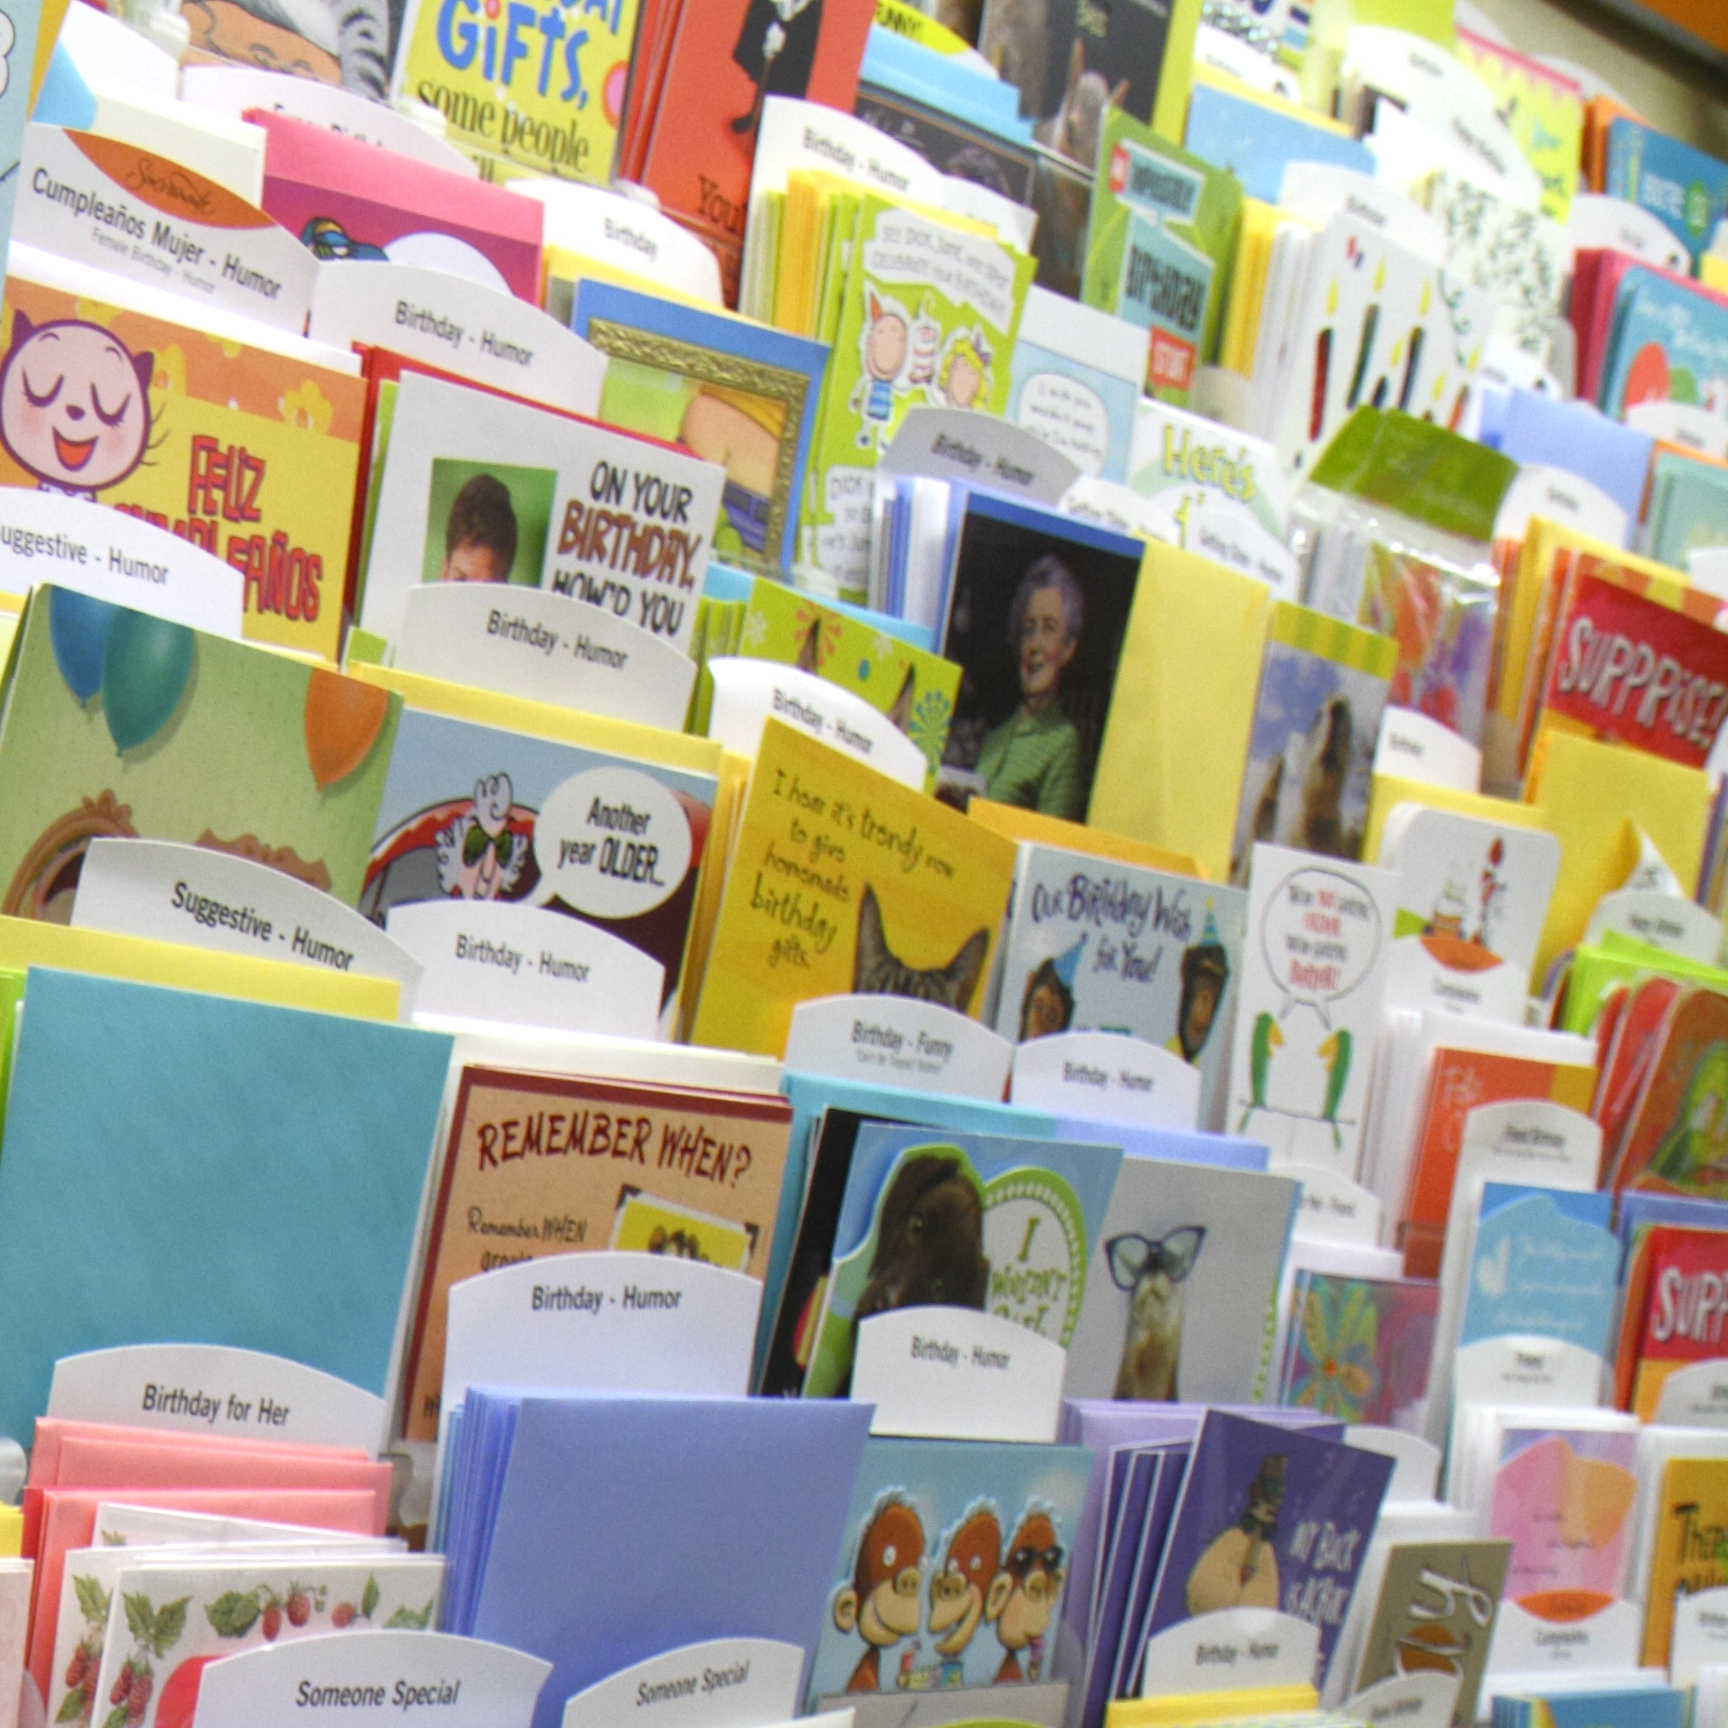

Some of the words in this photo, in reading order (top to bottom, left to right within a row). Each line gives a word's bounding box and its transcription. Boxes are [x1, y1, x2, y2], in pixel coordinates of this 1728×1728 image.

[418, 80, 496, 138] some
[501, 103, 589, 174] people
[32, 166, 146, 240] Cumpleaños
[151, 219, 205, 266] Mujer
[221, 253, 282, 300] Humor
[590, 461, 629, 504] ON
[632, 470, 693, 523] YOUR
[108, 547, 168, 585] Humor
[487, 610, 561, 655] Birthday
[574, 630, 629, 671] Humor
[586, 796, 652, 836] Another
[557, 835, 596, 869] year
[171, 882, 273, 942] Suggestive
[292, 927, 355, 972] Humor
[455, 934, 522, 969] Birthday
[539, 950, 591, 983] Humor
[478, 1110, 653, 1172] REMEMBER
[532, 1285, 603, 1316] Birthday
[622, 1286, 682, 1310] Humor
[142, 1384, 221, 1422] Birthday
[226, 1396, 253, 1422] for
[258, 1400, 289, 1428] Her
[295, 1680, 385, 1709] Someone
[392, 1679, 460, 1710] Special
[635, 1677, 698, 1707] Someone
[702, 1659, 750, 1694] Special
